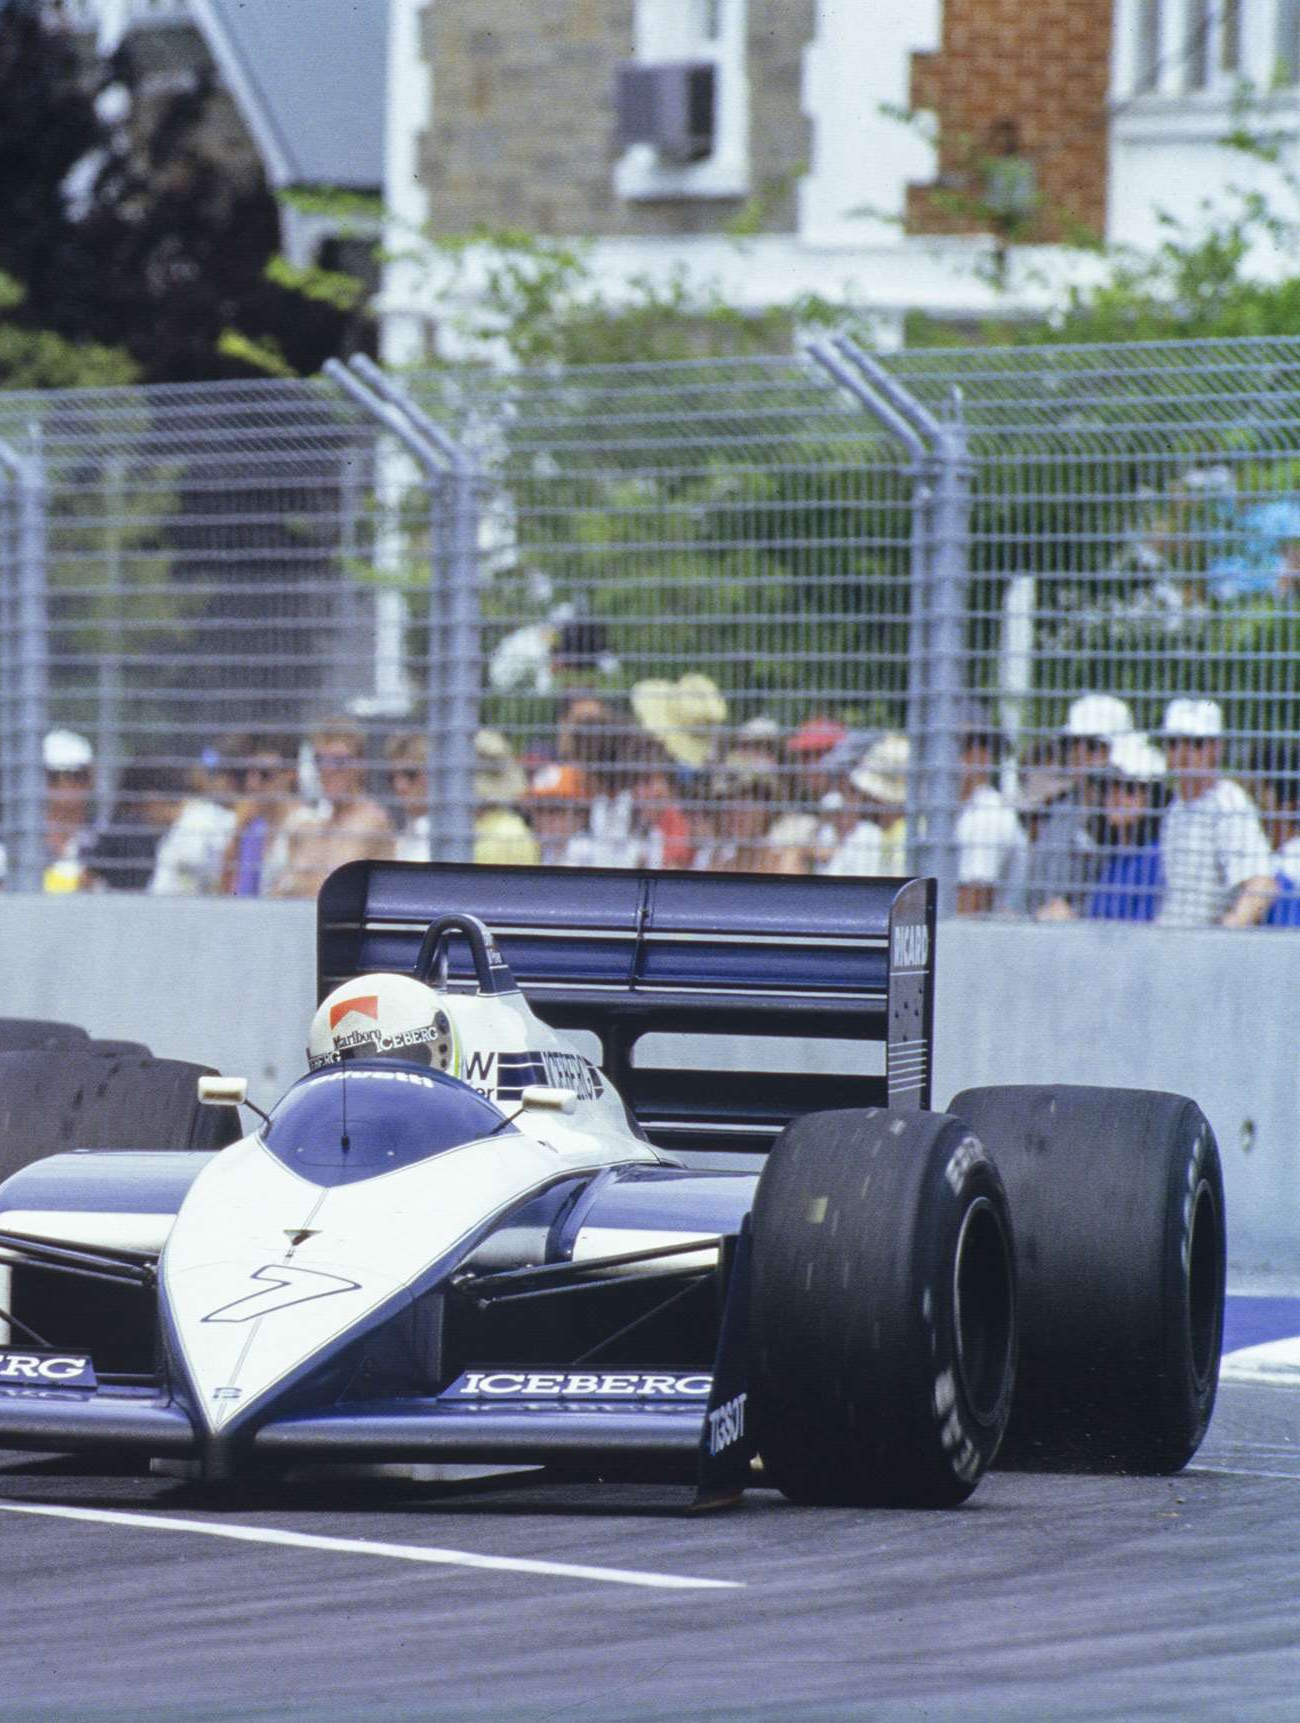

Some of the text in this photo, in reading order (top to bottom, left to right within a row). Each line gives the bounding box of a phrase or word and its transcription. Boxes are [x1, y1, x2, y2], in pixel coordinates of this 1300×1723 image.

[371, 1026, 438, 1053] ICEBERG
[200, 1264, 363, 1322] 7
[460, 1374, 714, 1394] ICEBERG
[709, 1392, 747, 1457] TISSOT
